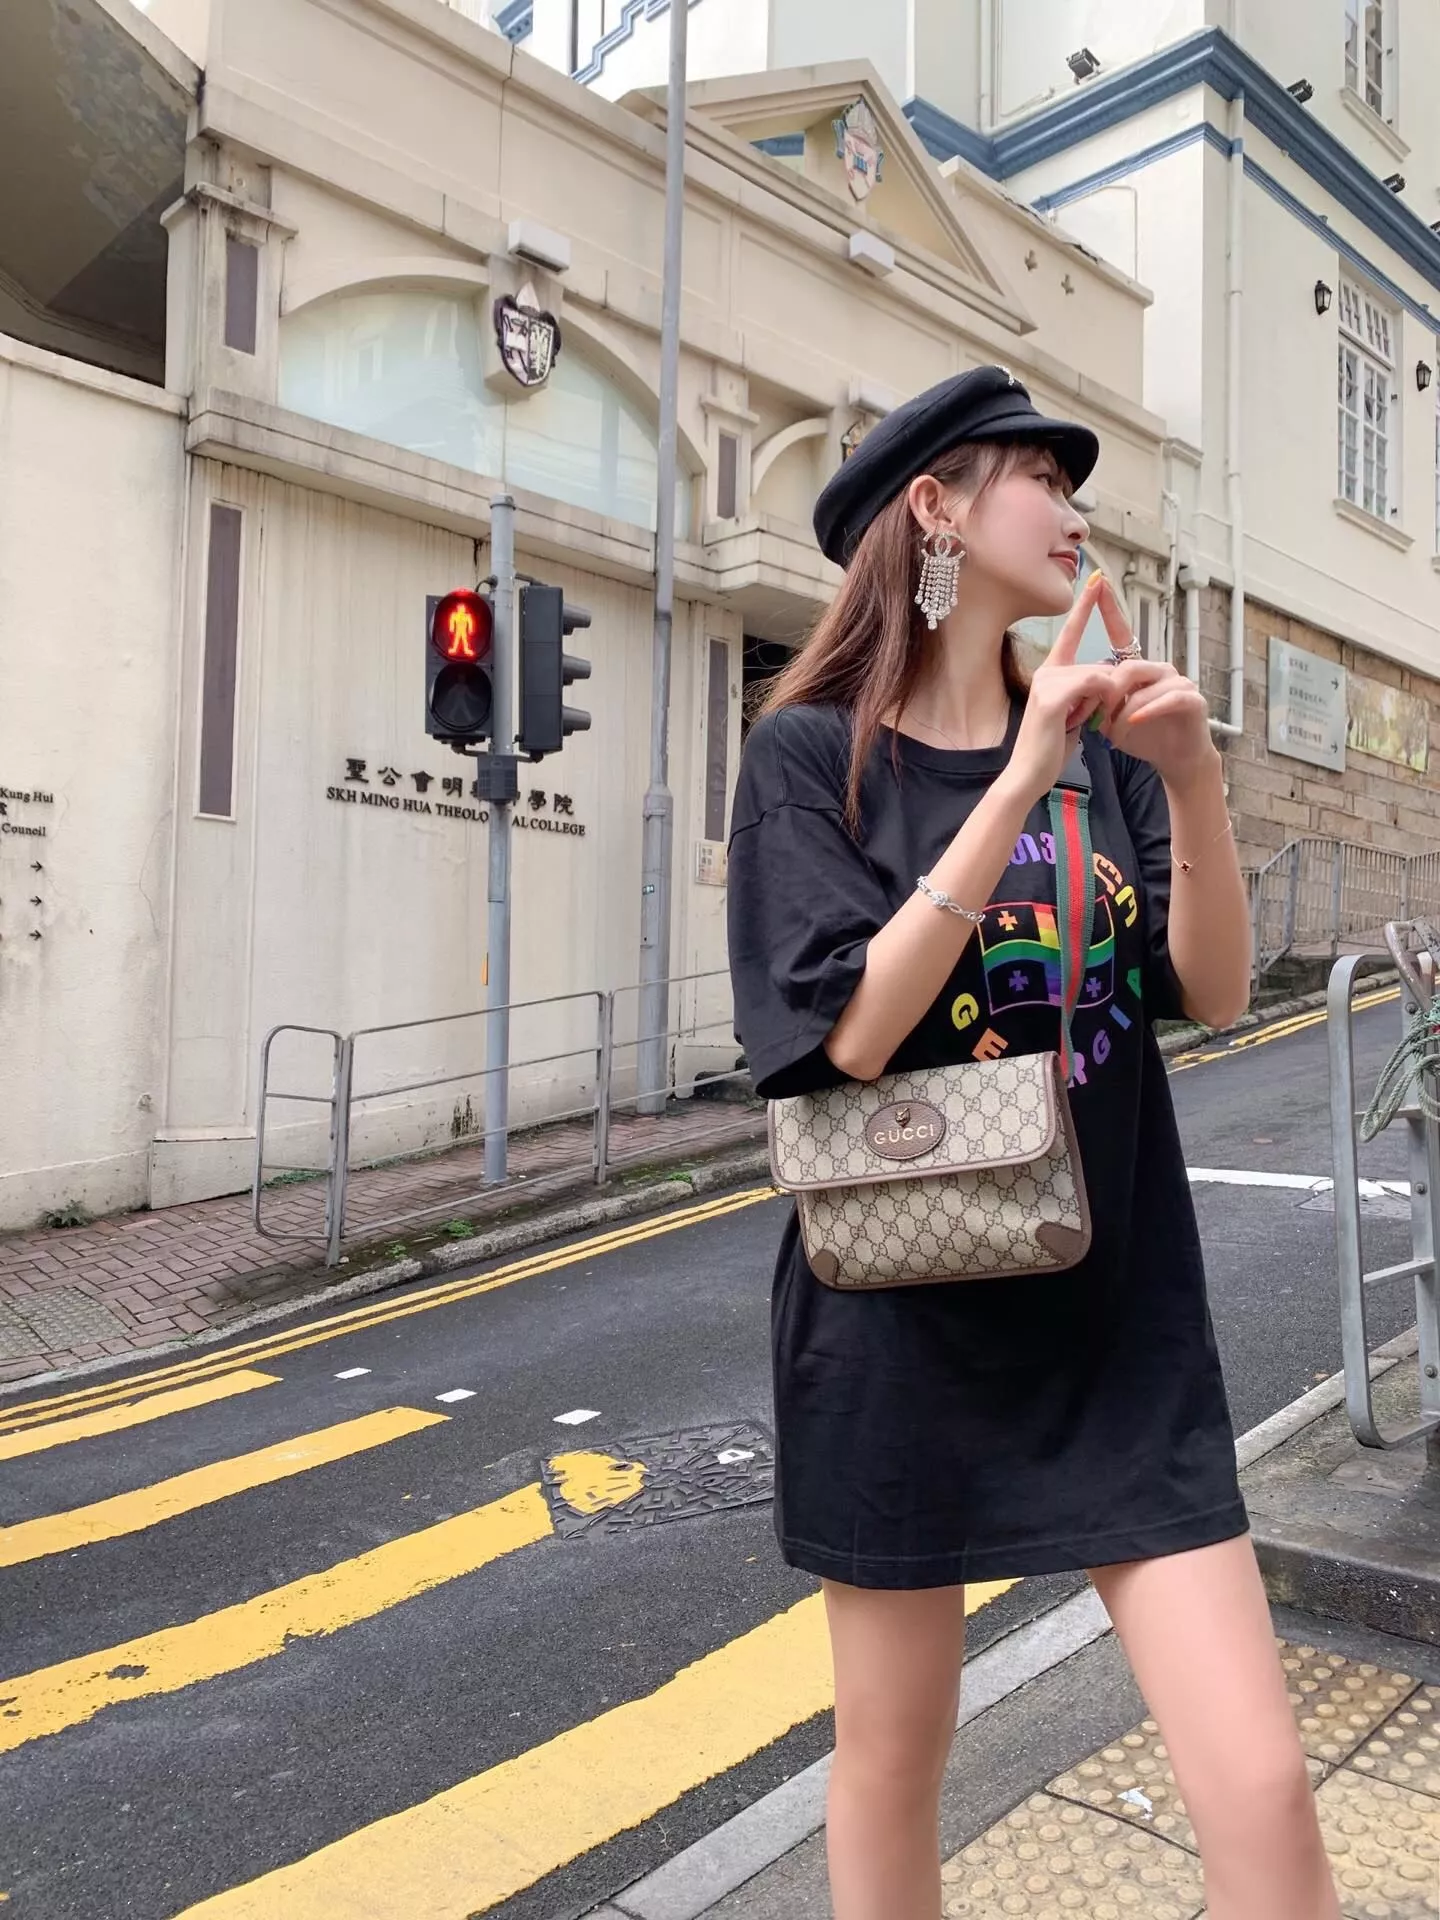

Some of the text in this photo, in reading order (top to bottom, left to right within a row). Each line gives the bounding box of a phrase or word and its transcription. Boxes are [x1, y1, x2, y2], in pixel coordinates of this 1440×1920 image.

[0, 786, 54, 804] Kung Hui
[344, 758, 574, 817] 聖公會明學院
[326, 785, 586, 837] SKH MING HUA THEOLOAL COLLEGE
[1, 822, 46, 837] Council
[874, 1123, 934, 1145] GUCCI
